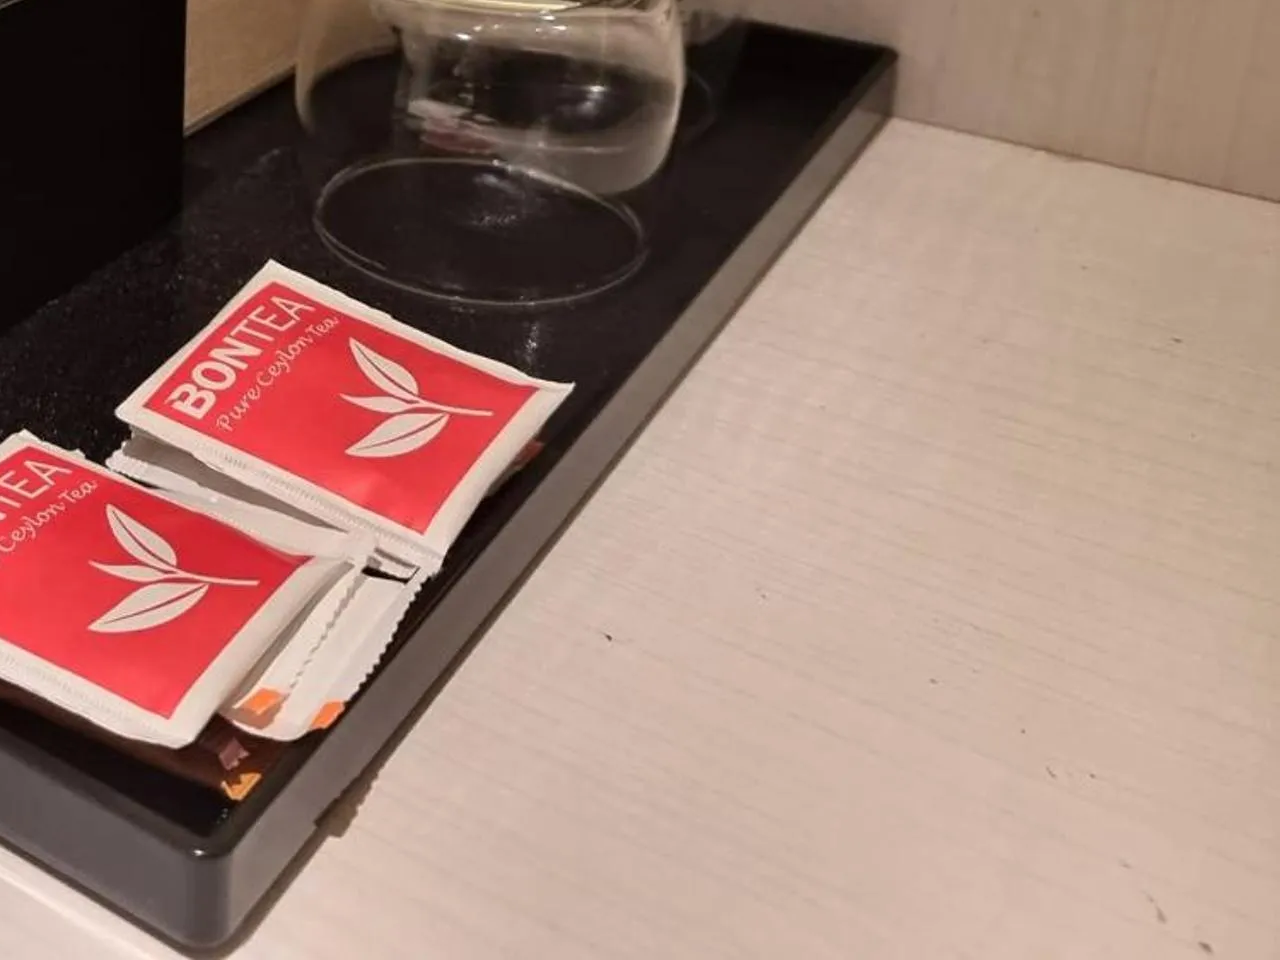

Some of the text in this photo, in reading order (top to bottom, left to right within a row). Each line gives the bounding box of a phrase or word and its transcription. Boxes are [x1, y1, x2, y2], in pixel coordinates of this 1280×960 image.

[164, 296, 316, 420] BONTEA
[216, 315, 340, 433] Pure Ceylon Tea
[60, 479, 99, 505] Tea
